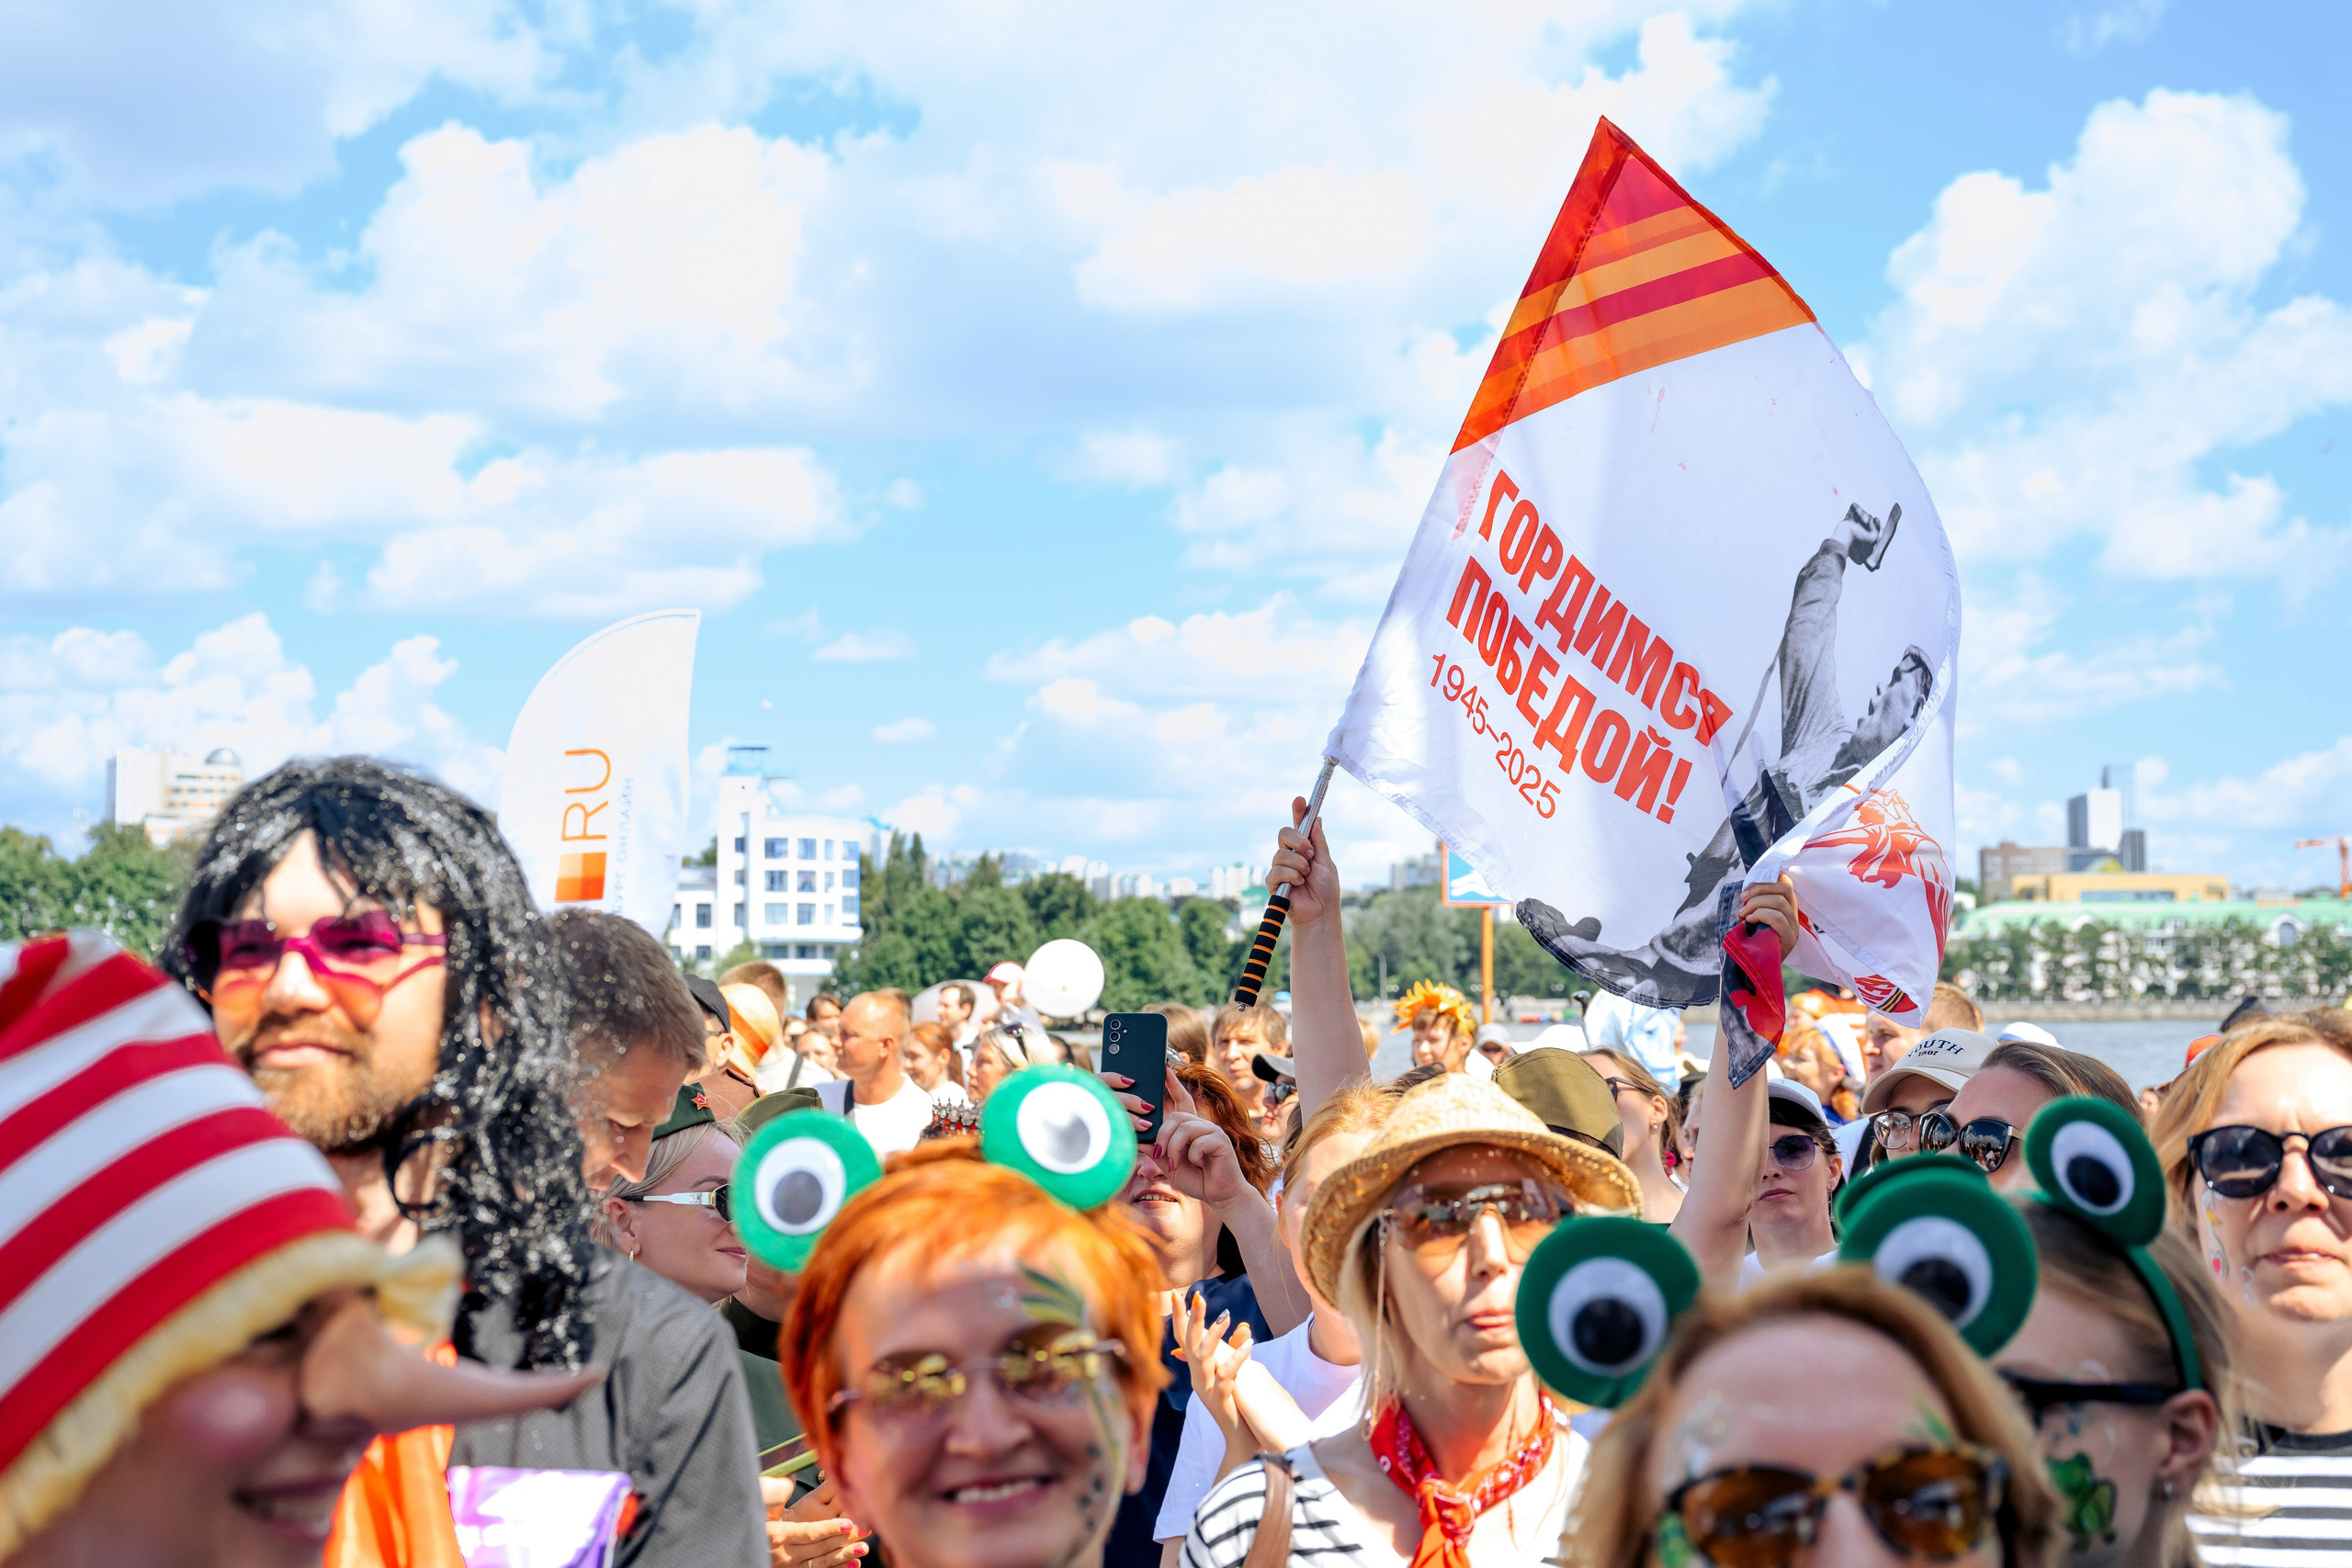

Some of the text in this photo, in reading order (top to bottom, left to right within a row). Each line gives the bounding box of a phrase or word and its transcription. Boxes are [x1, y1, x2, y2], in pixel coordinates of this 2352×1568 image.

[1446, 556, 1693, 824] ПОБЕДОЙ!
[1478, 469, 1733, 747] ГОРДИМСЯ
[561, 748, 612, 841] RU
[1907, 1039, 1964, 1057] YOUTH
